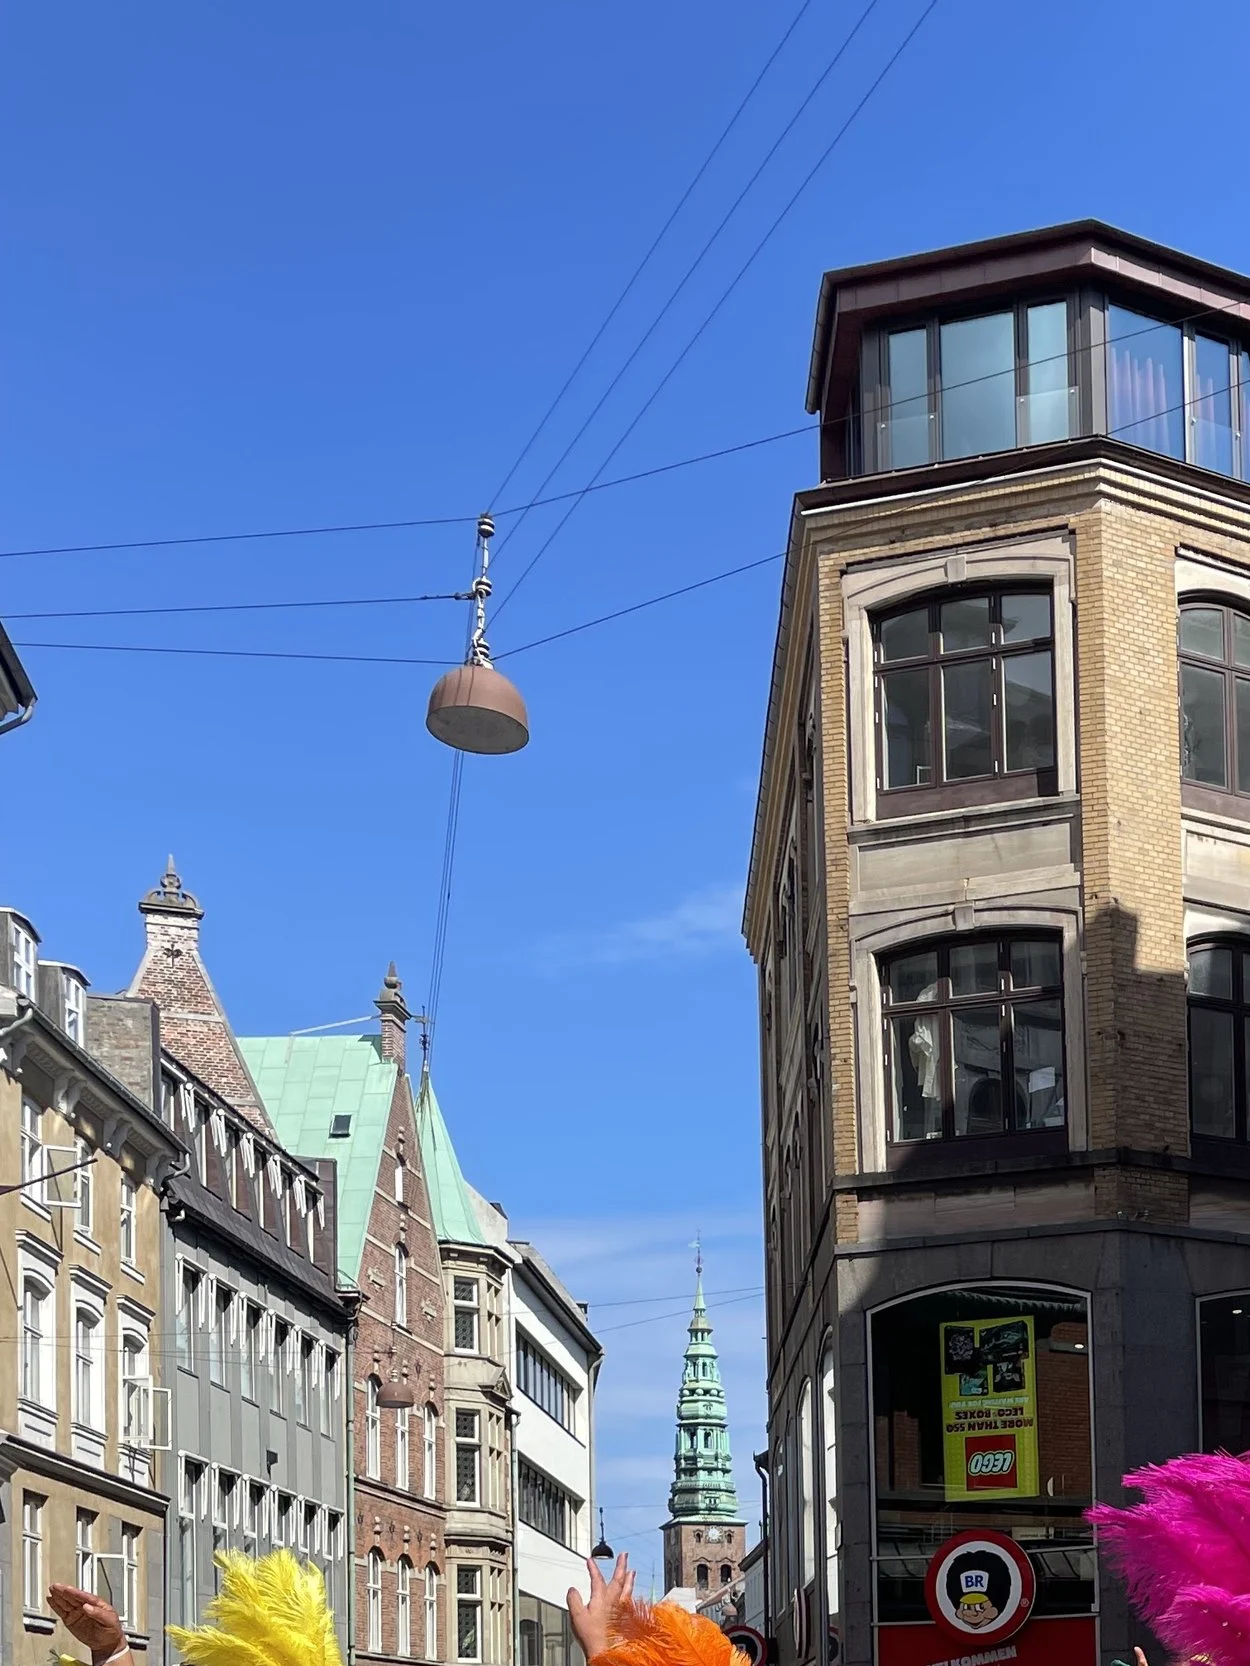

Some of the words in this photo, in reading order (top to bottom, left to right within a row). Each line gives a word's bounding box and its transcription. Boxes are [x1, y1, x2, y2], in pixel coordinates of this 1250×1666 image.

[955, 1408, 992, 1420] BOXES
[946, 1423, 966, 1433] 550
[968, 1420, 998, 1431] THAN
[1001, 1418, 1033, 1429] MORE
[969, 1451, 1014, 1475] LEGO
[965, 1575, 984, 1587] BR
